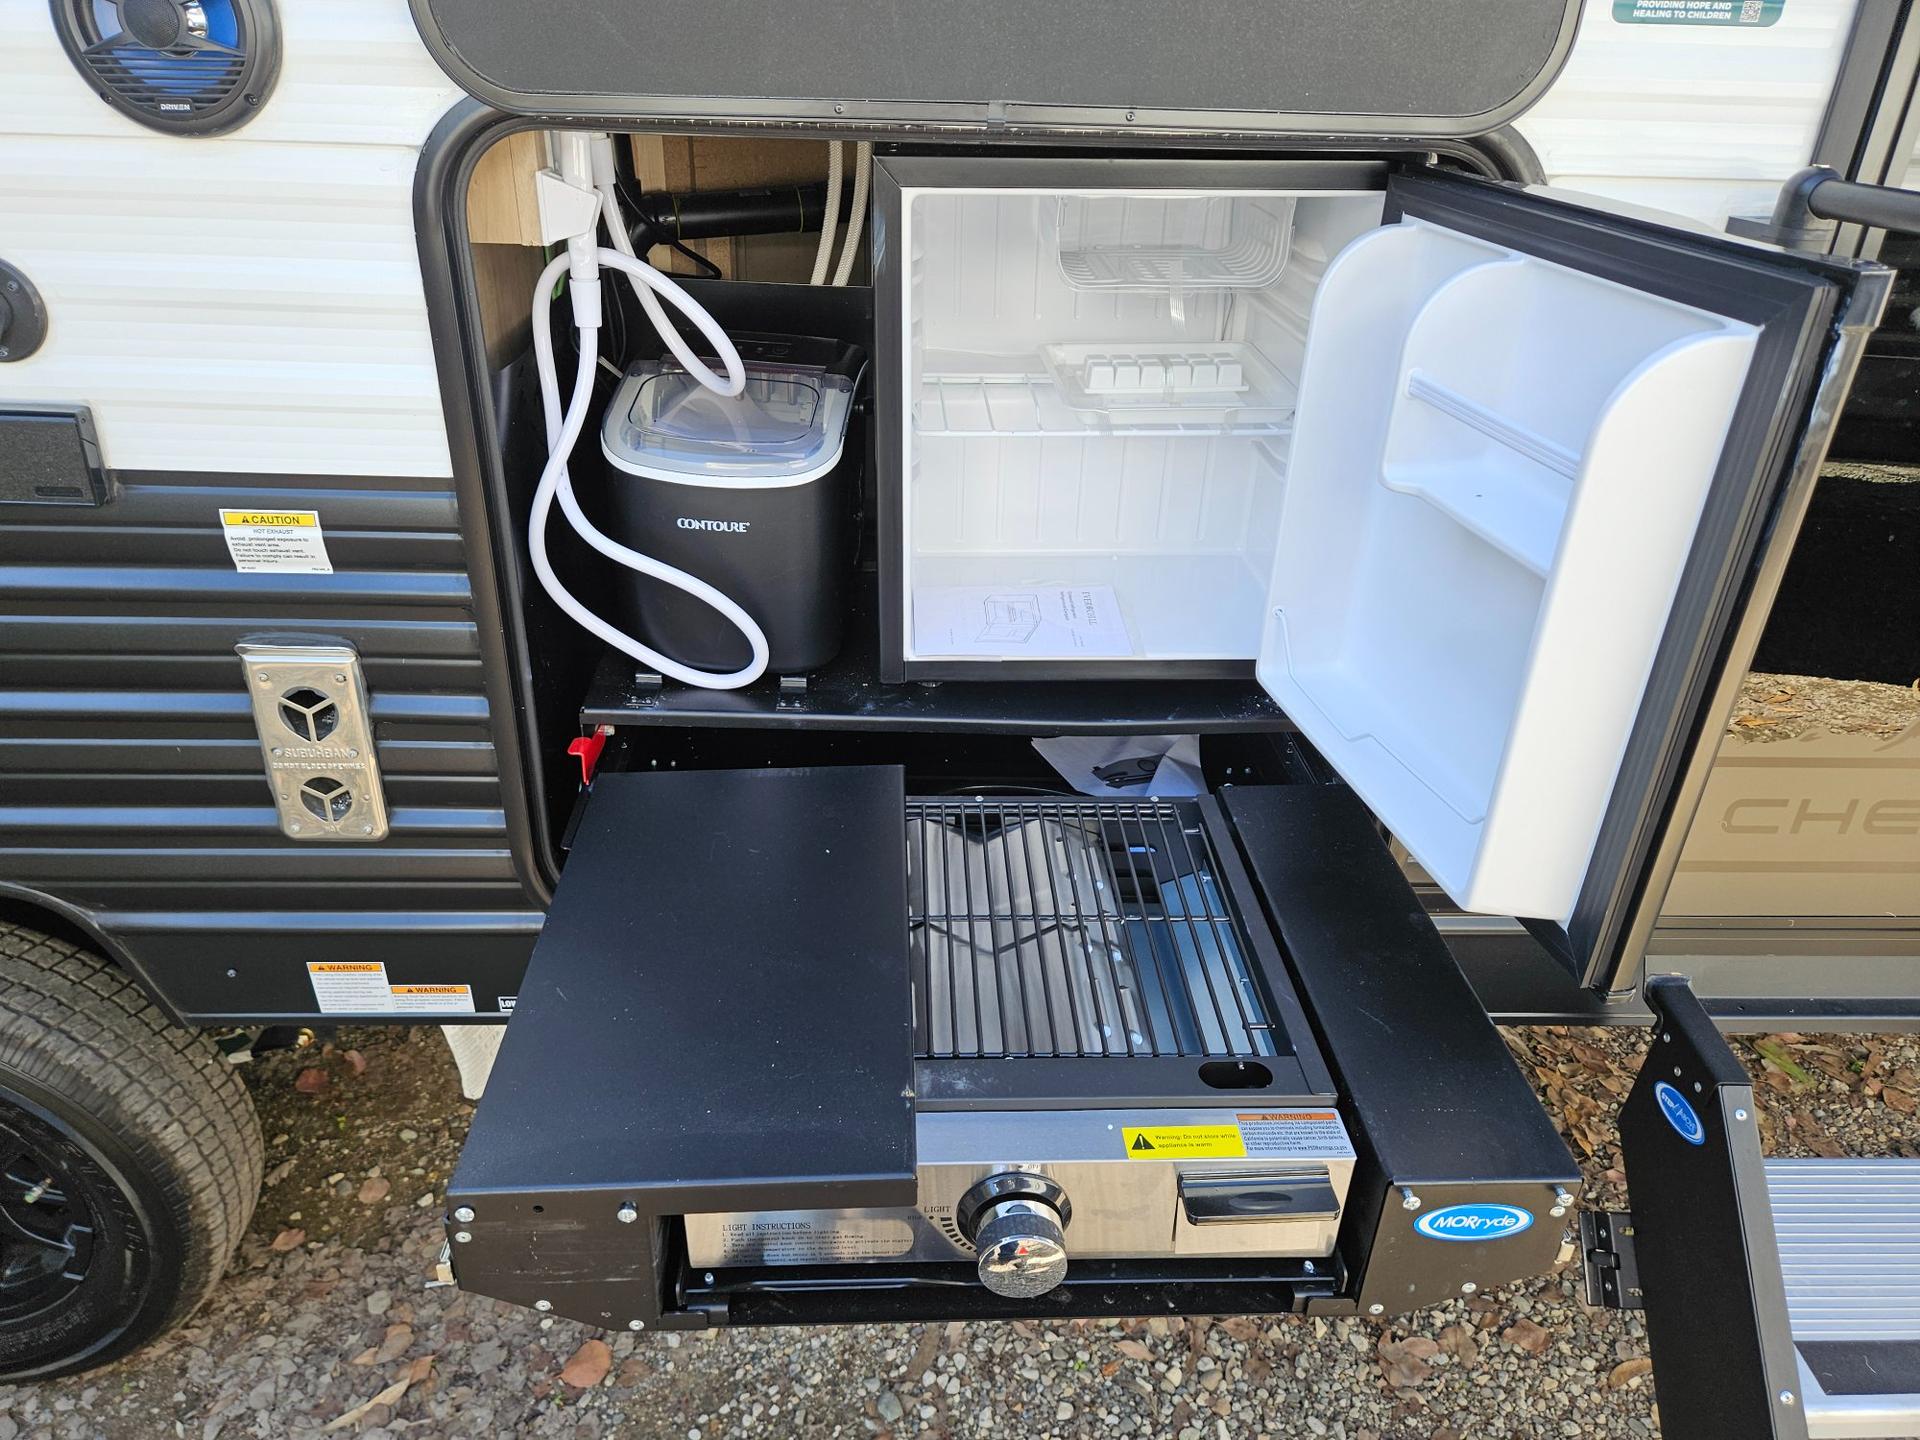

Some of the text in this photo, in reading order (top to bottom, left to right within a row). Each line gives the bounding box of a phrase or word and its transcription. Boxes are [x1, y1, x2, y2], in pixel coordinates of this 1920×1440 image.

[1636, 0, 1686, 8] PROVIDING
[1712, 2, 1732, 10] AND
[1632, 9, 1672, 18] HEALING
[1687, 11, 1731, 19] CHILDREN
[252, 516, 300, 524] CAUTION
[677, 518, 748, 532] CONTOURE
[284, 748, 350, 759] SUBURBAN
[1721, 798, 1920, 834] CHE
[752, 1222, 811, 1230] INSTRUCTIONS
[1433, 1214, 1516, 1229] MORryde
